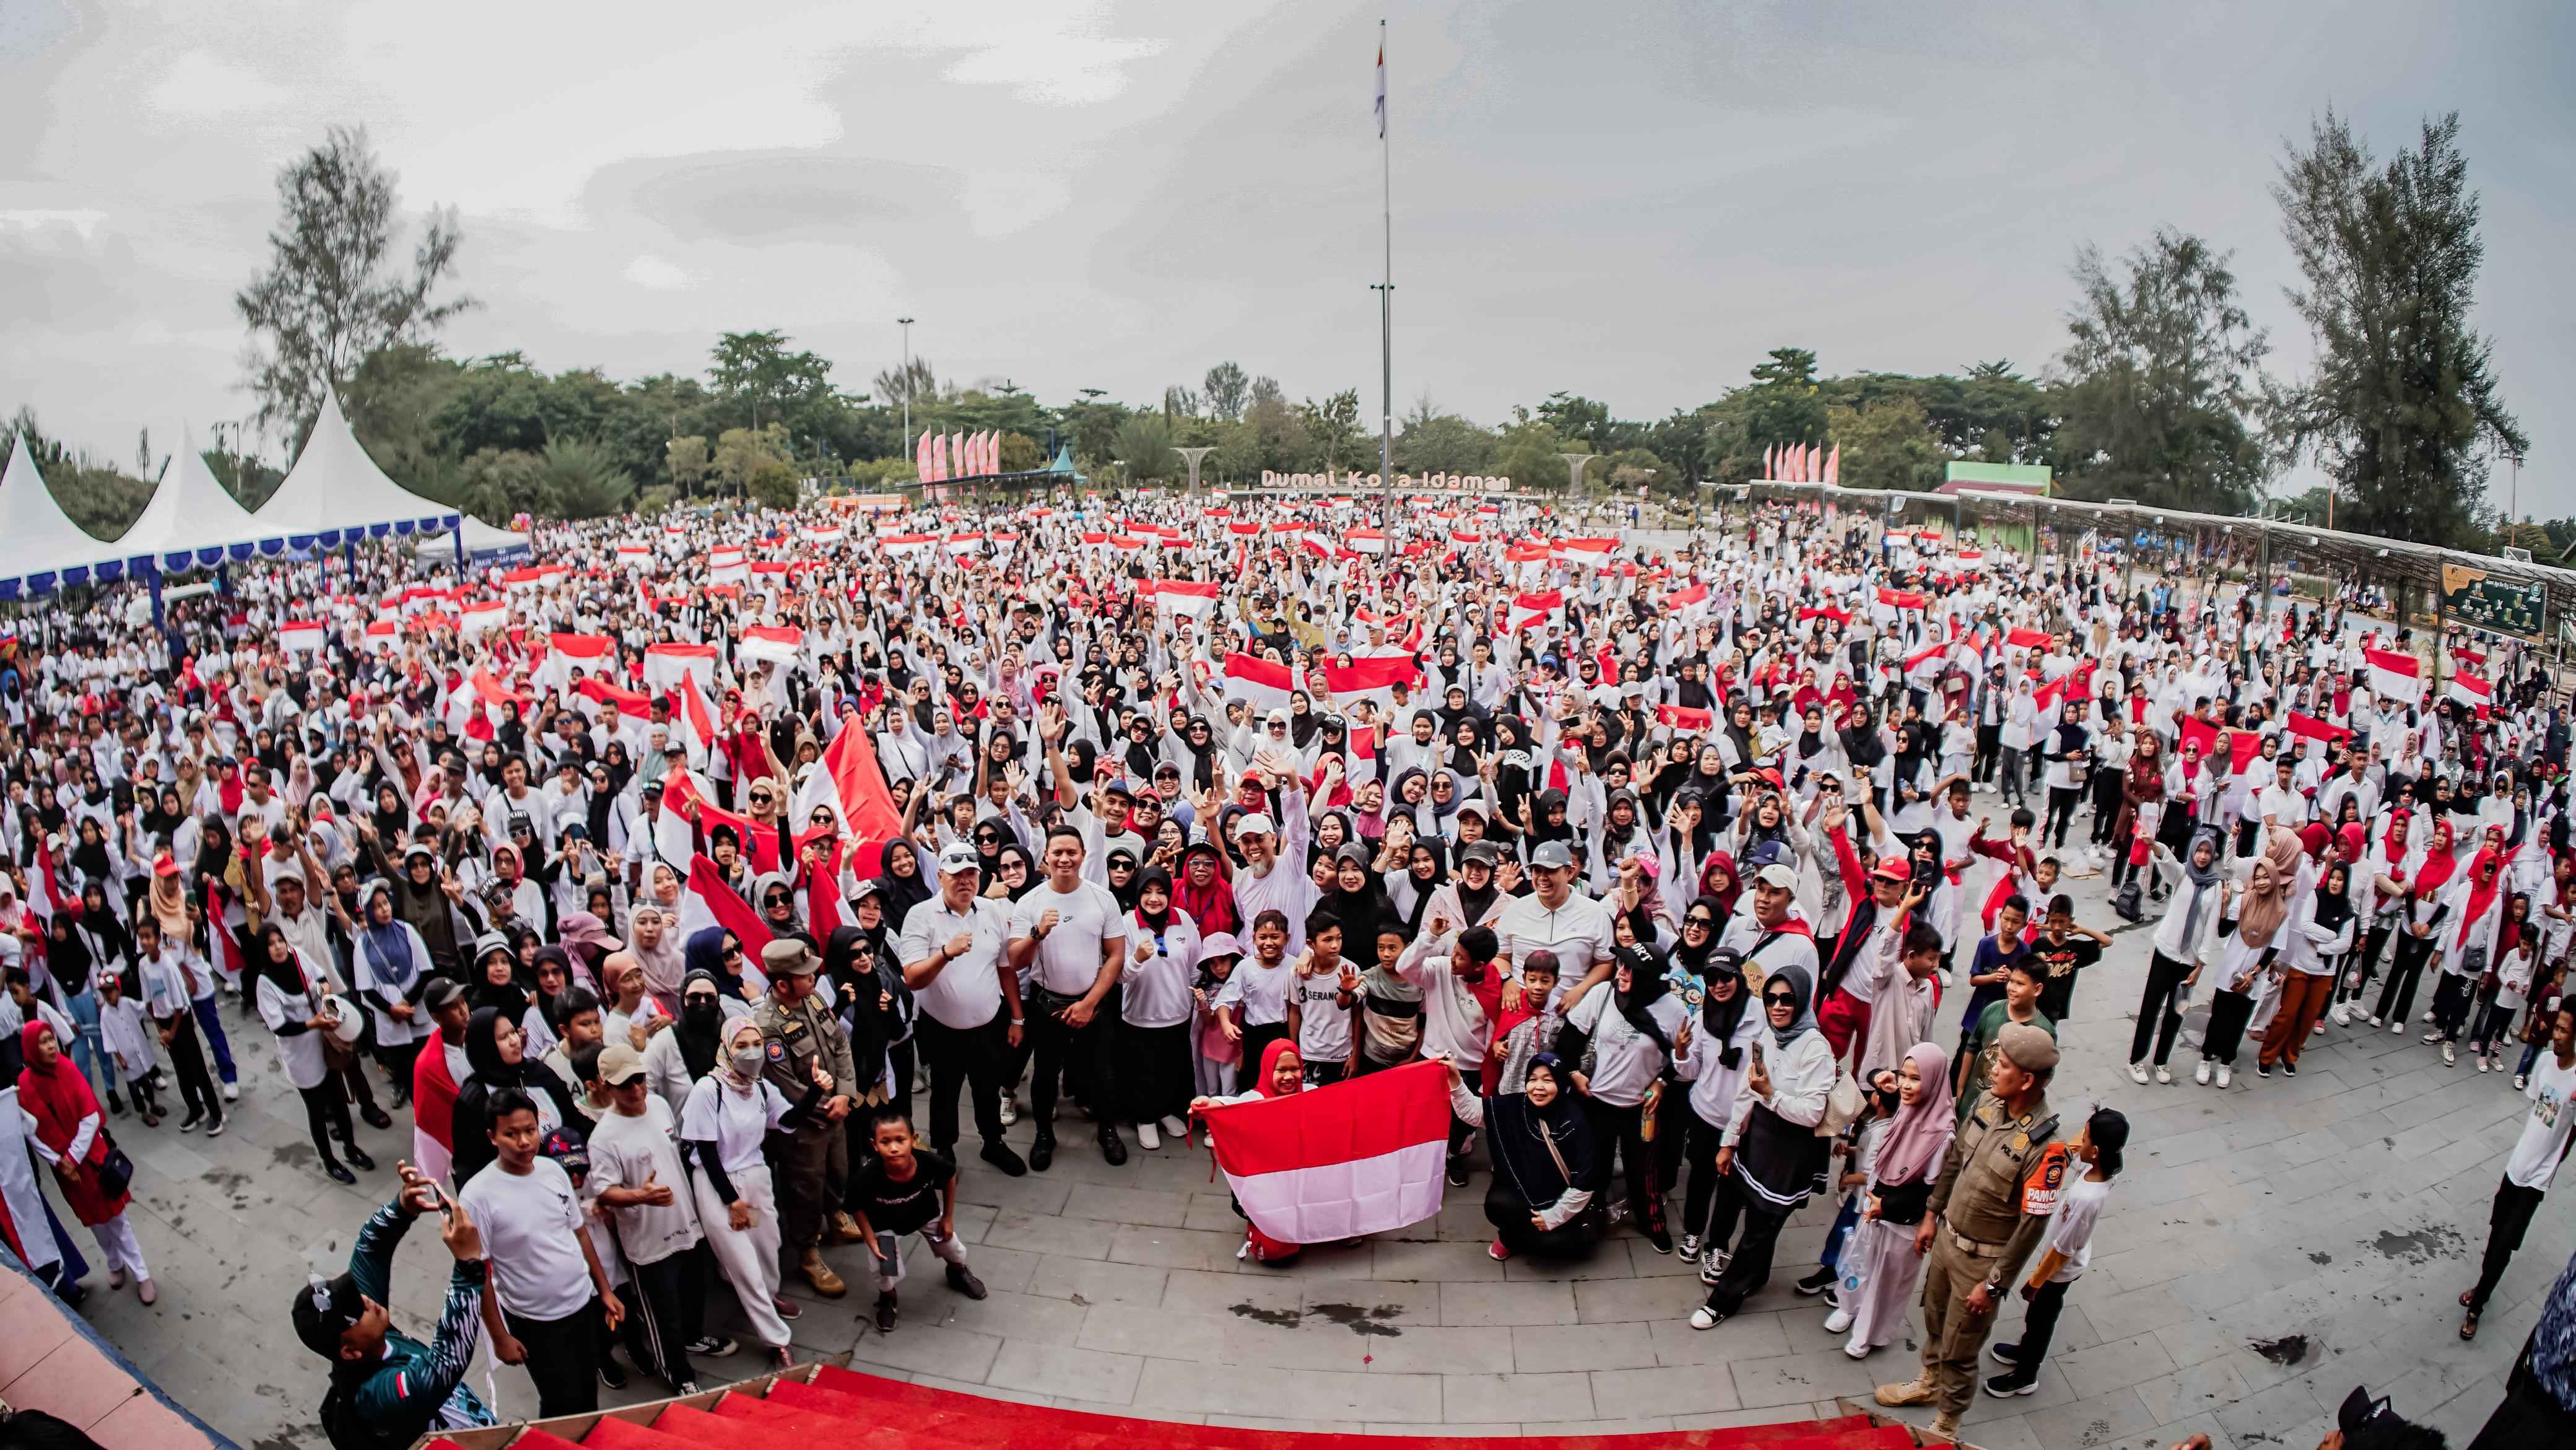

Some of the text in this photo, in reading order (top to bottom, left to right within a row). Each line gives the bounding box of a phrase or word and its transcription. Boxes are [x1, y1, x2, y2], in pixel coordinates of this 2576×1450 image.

[1261, 470, 1511, 491] Dumai Koa Idaman
